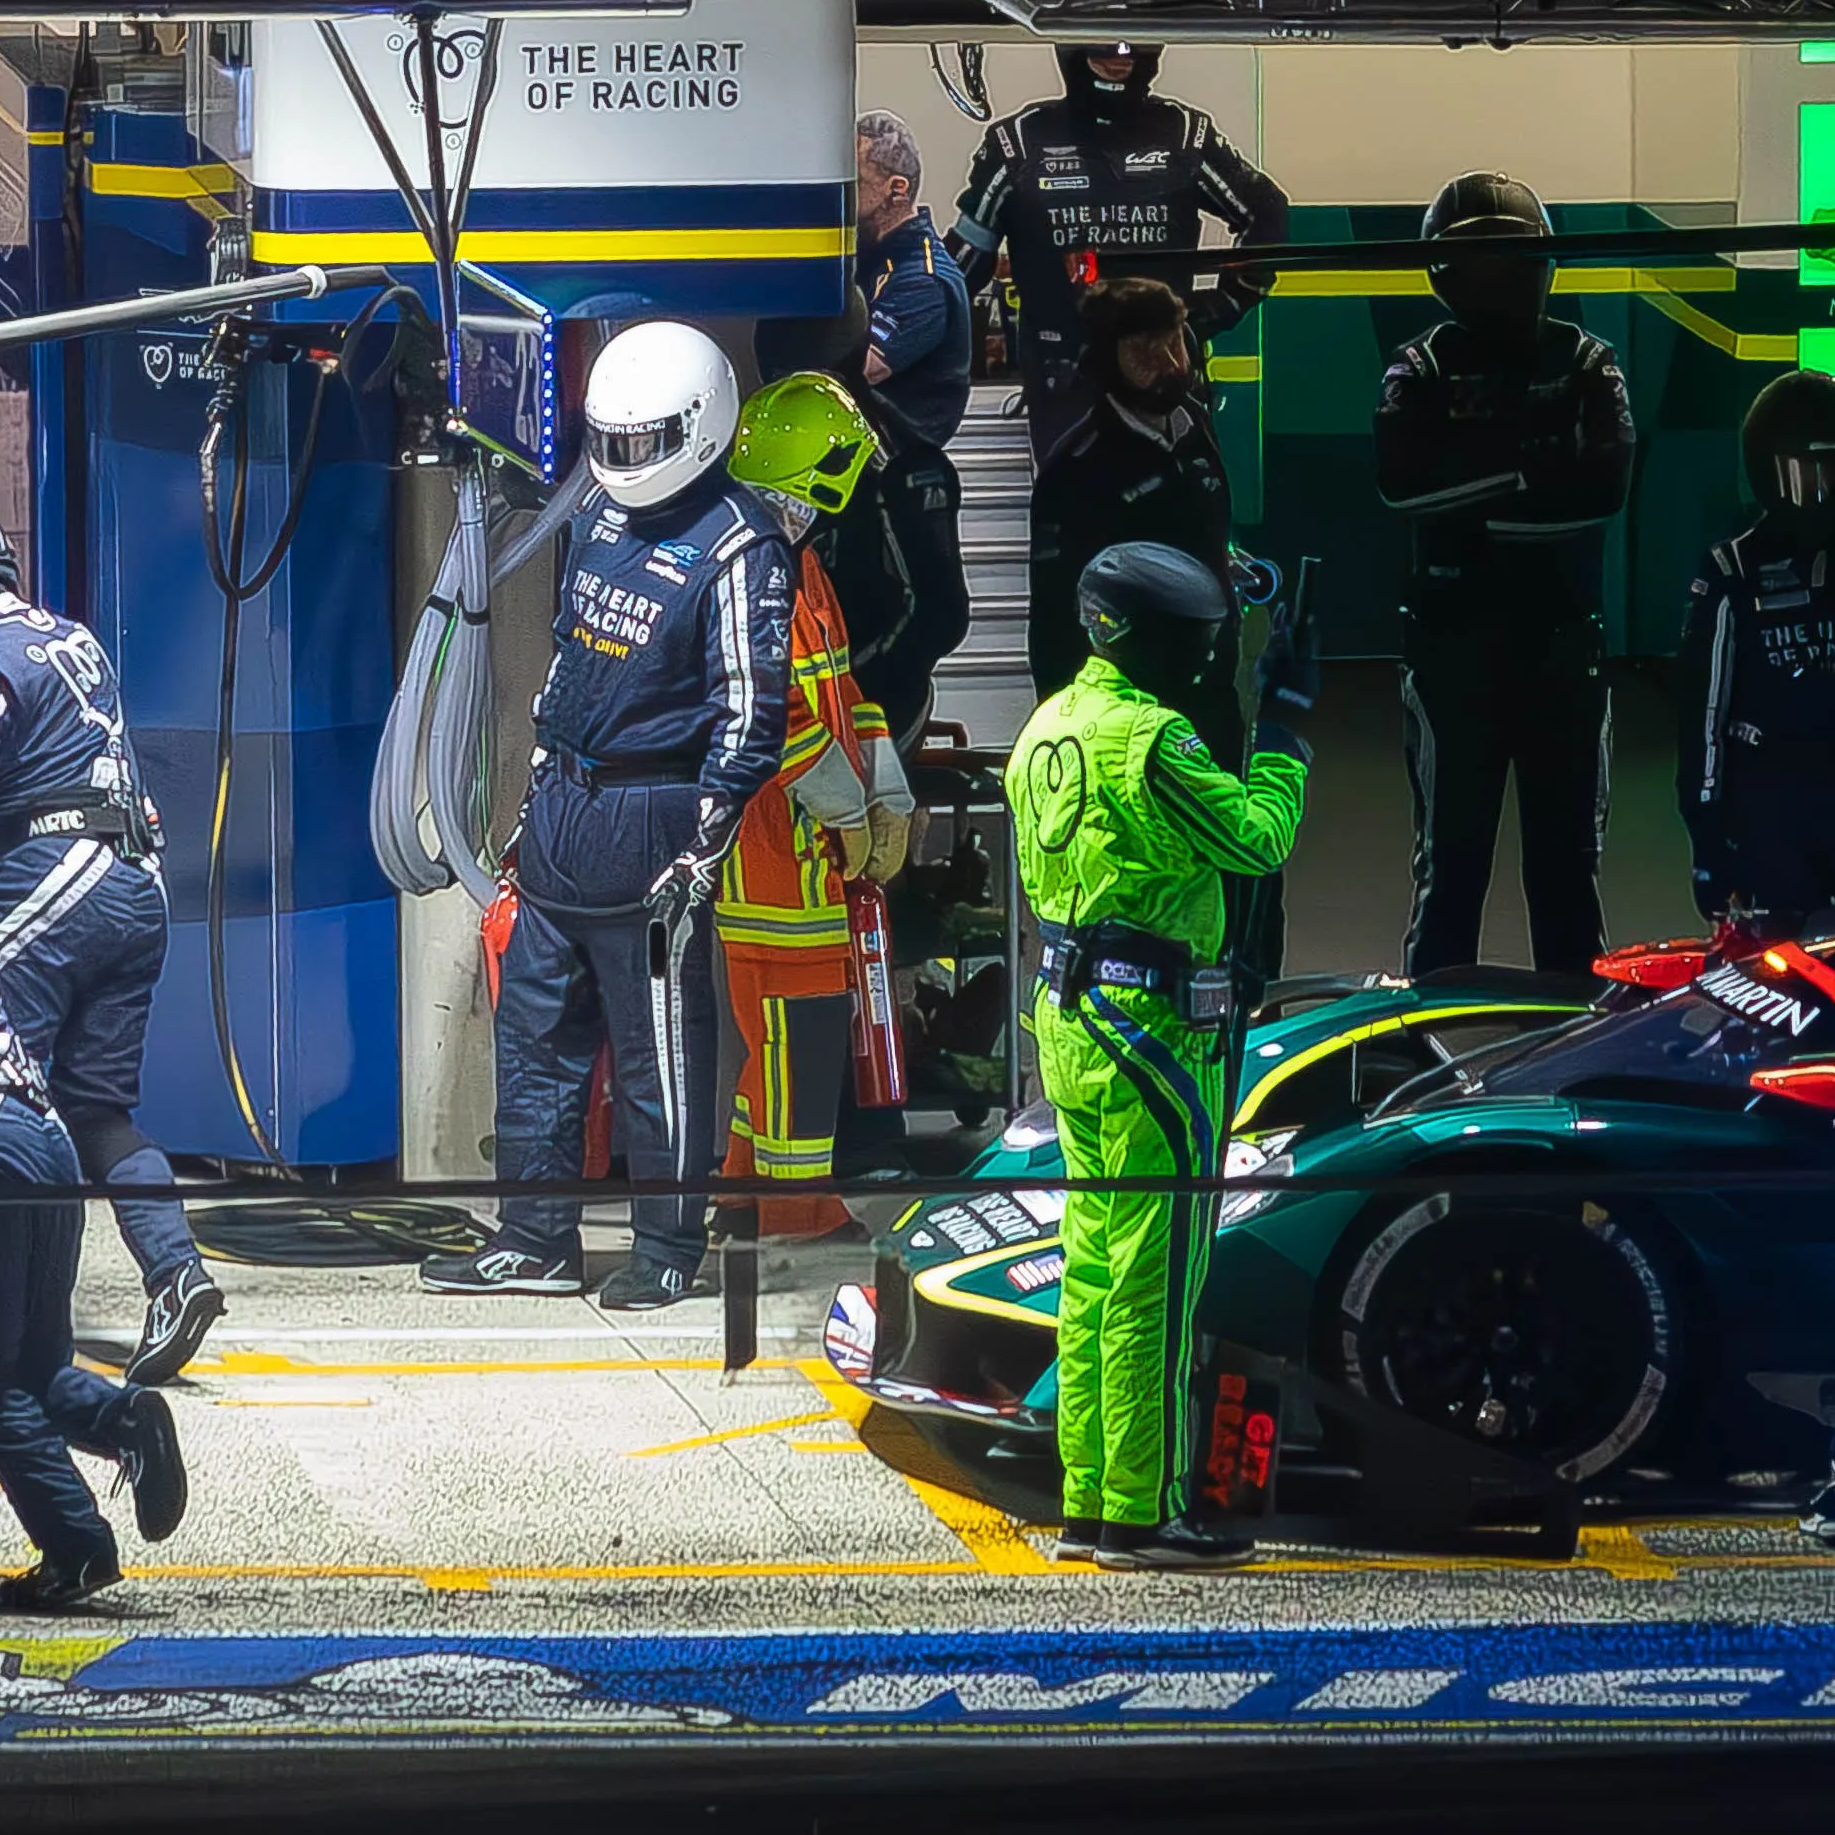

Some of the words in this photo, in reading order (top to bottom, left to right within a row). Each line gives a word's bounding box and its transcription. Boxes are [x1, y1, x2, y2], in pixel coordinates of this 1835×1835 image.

[521, 45, 597, 75] THE
[614, 42, 744, 73] HEART
[527, 82, 575, 110] OF
[592, 79, 739, 110] RACING
[1047, 207, 1093, 225] THE
[573, 569, 602, 598] THE
